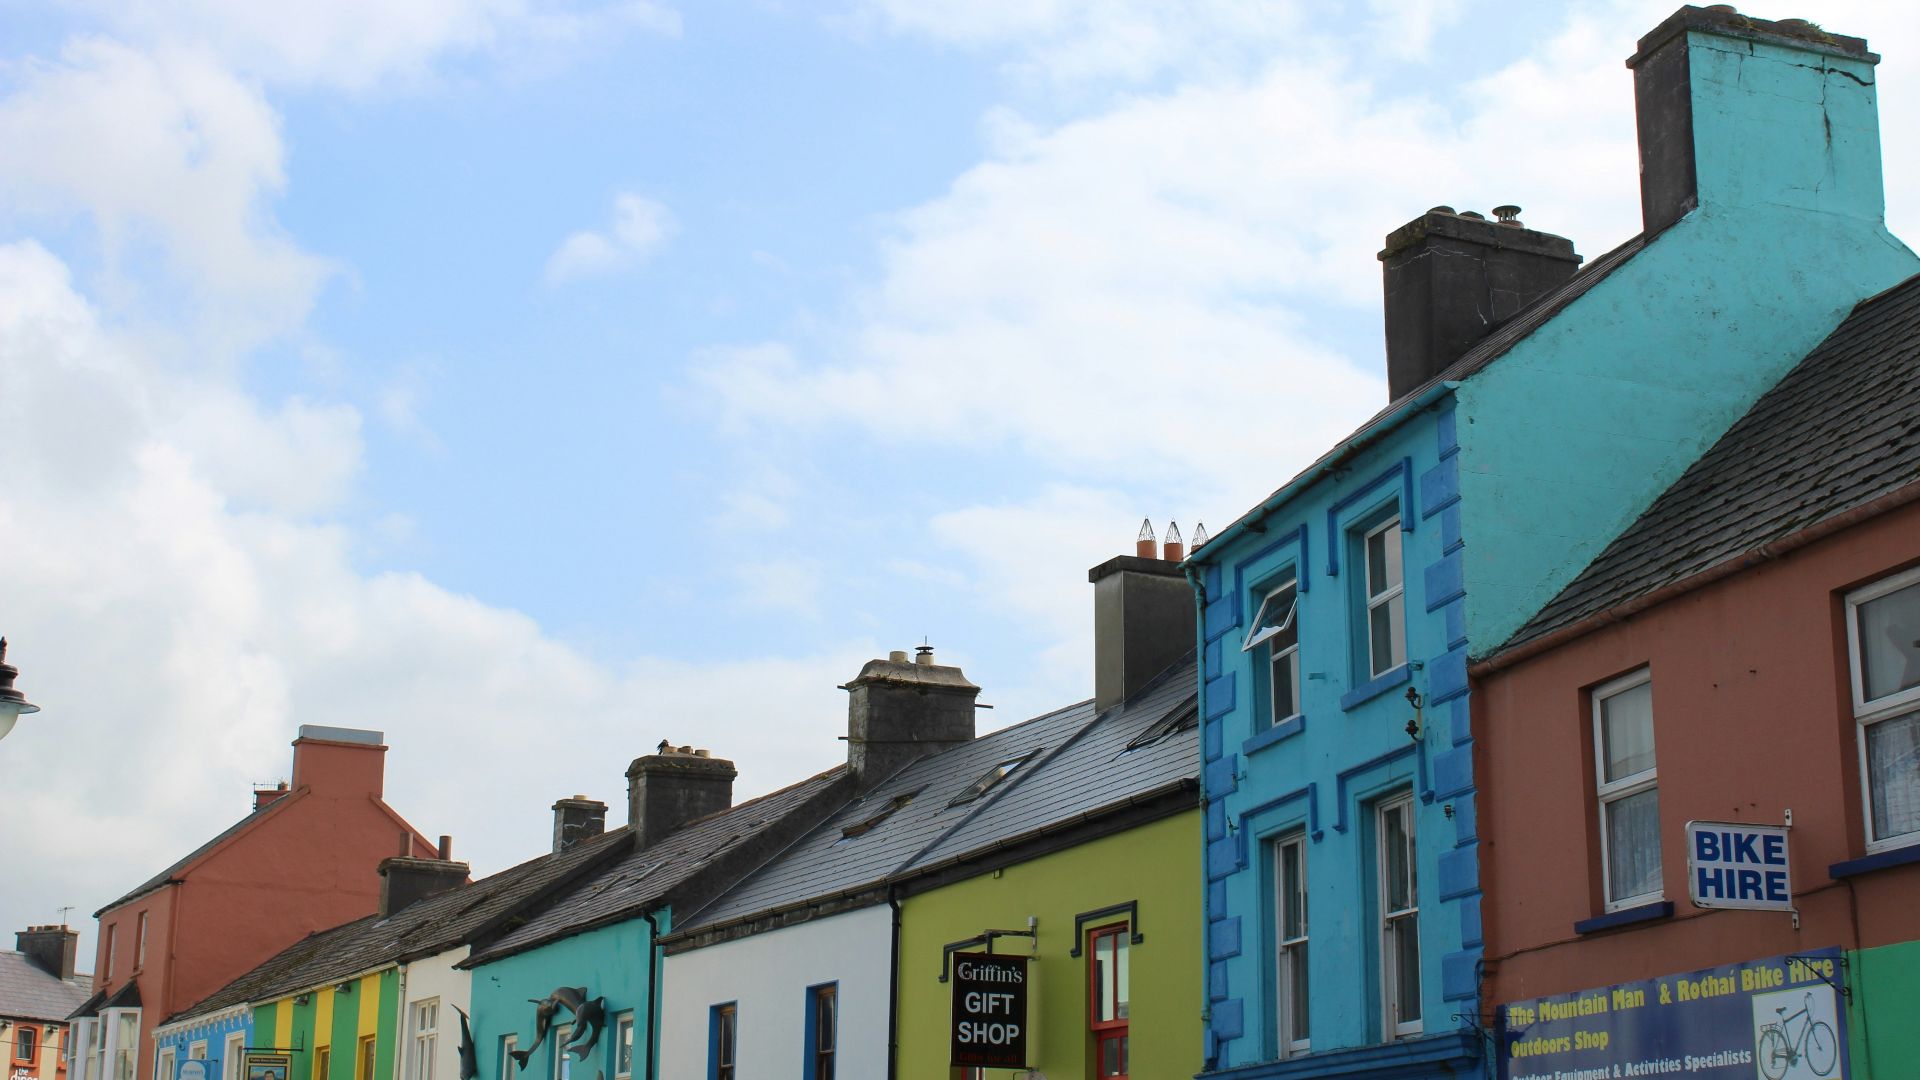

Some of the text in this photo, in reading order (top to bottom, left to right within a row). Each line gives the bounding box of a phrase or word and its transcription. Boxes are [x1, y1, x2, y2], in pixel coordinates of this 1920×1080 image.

[1695, 831, 1786, 865] BIKE
[1697, 867, 1788, 901] HIRE
[957, 962, 1023, 983] Griffin's
[965, 992, 1015, 1015] GIFT
[1510, 1006, 1536, 1027] The
[1538, 993, 1608, 1022] Mountain
[1612, 989, 1645, 1011] Man
[1659, 983, 1673, 1005] &
[1741, 966, 1784, 992] Bike
[1789, 958, 1834, 984] Hire
[957, 1021, 1020, 1045] SHOP
[1511, 1030, 1609, 1058] Outdoors Shop
[1613, 1063, 1622, 1078] &
[1624, 1057, 1681, 1077] Activities
[1684, 1050, 1752, 1073] Specialists
